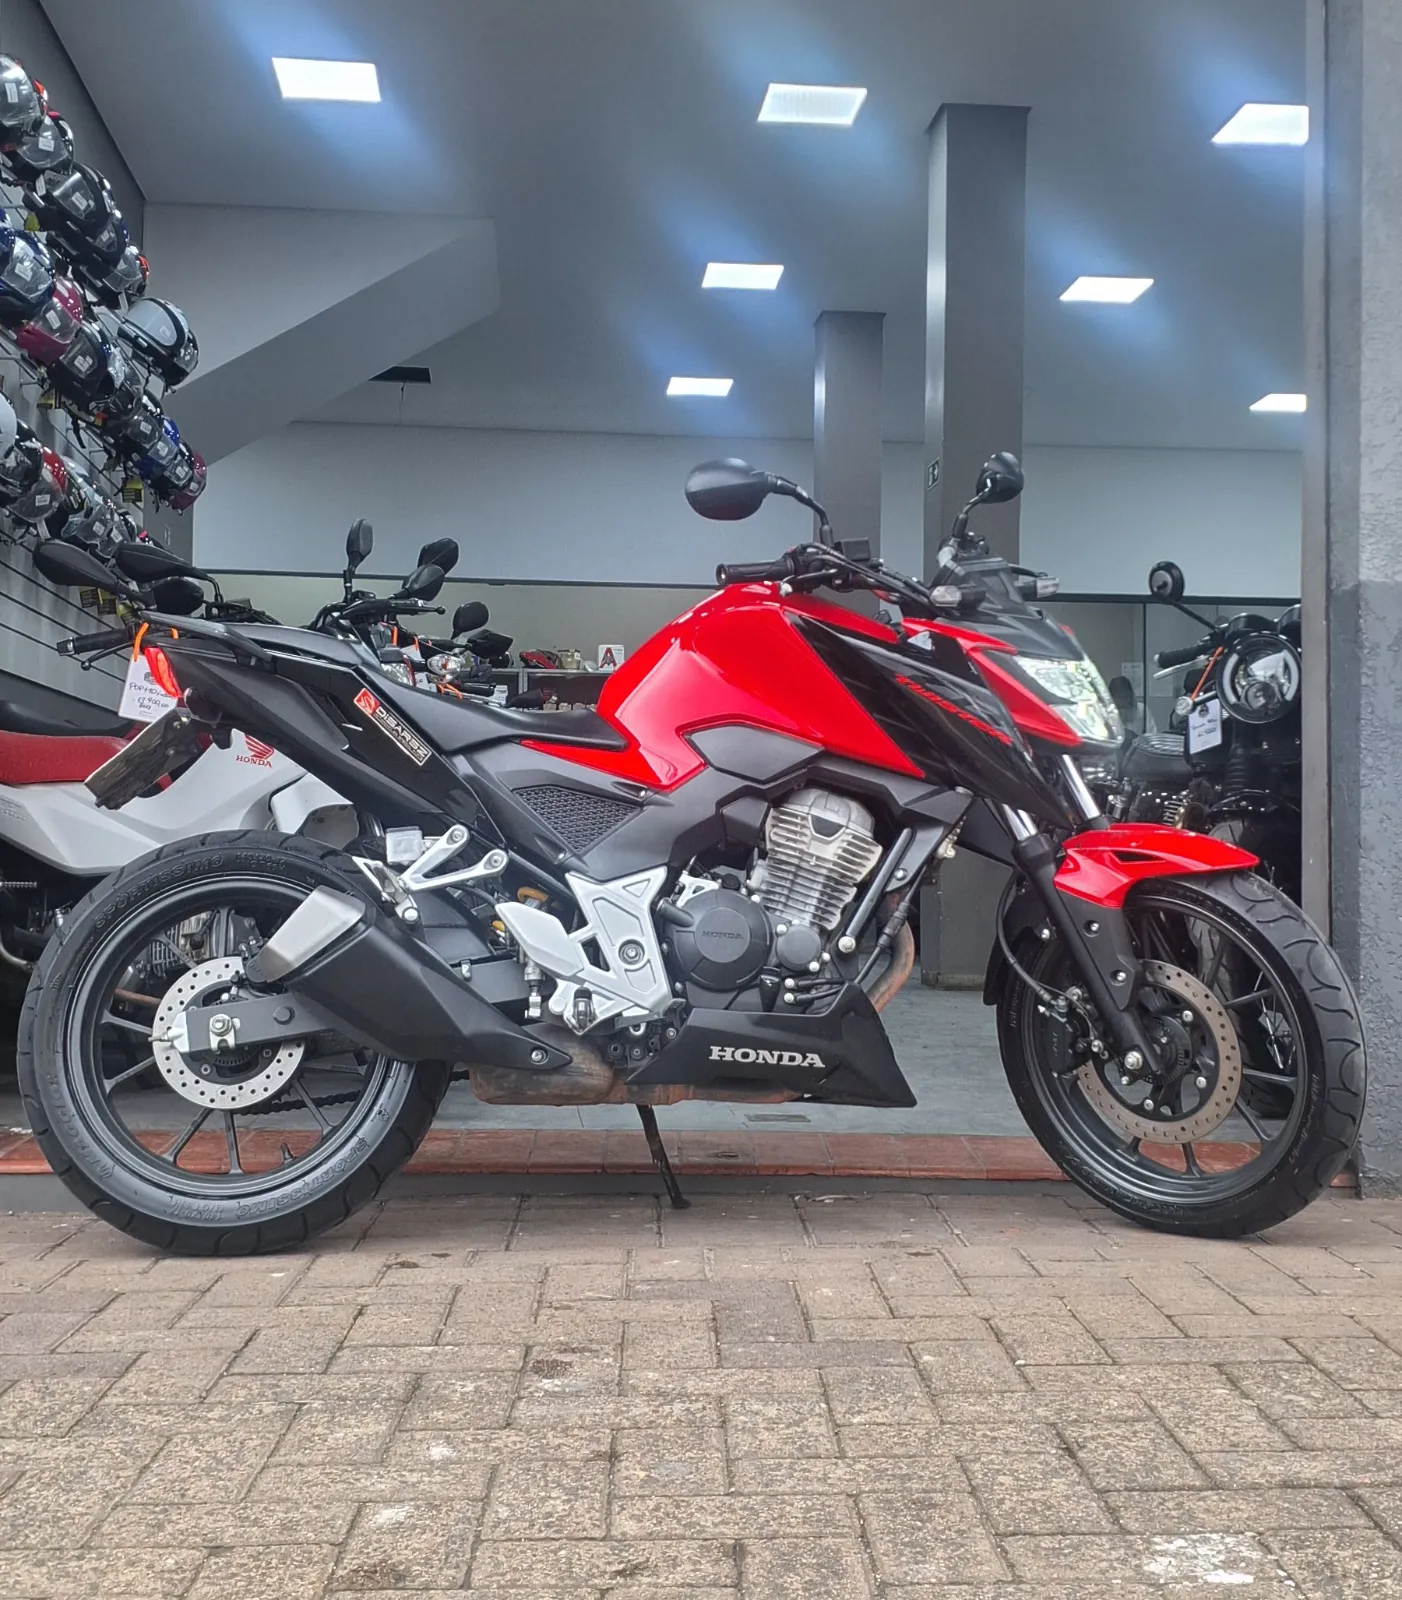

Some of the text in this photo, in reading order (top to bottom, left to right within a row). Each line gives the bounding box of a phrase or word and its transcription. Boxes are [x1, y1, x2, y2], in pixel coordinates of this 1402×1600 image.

[236, 755, 273, 768] HONDA
[702, 930, 745, 940] HONDA
[709, 1046, 826, 1068] HONDA
